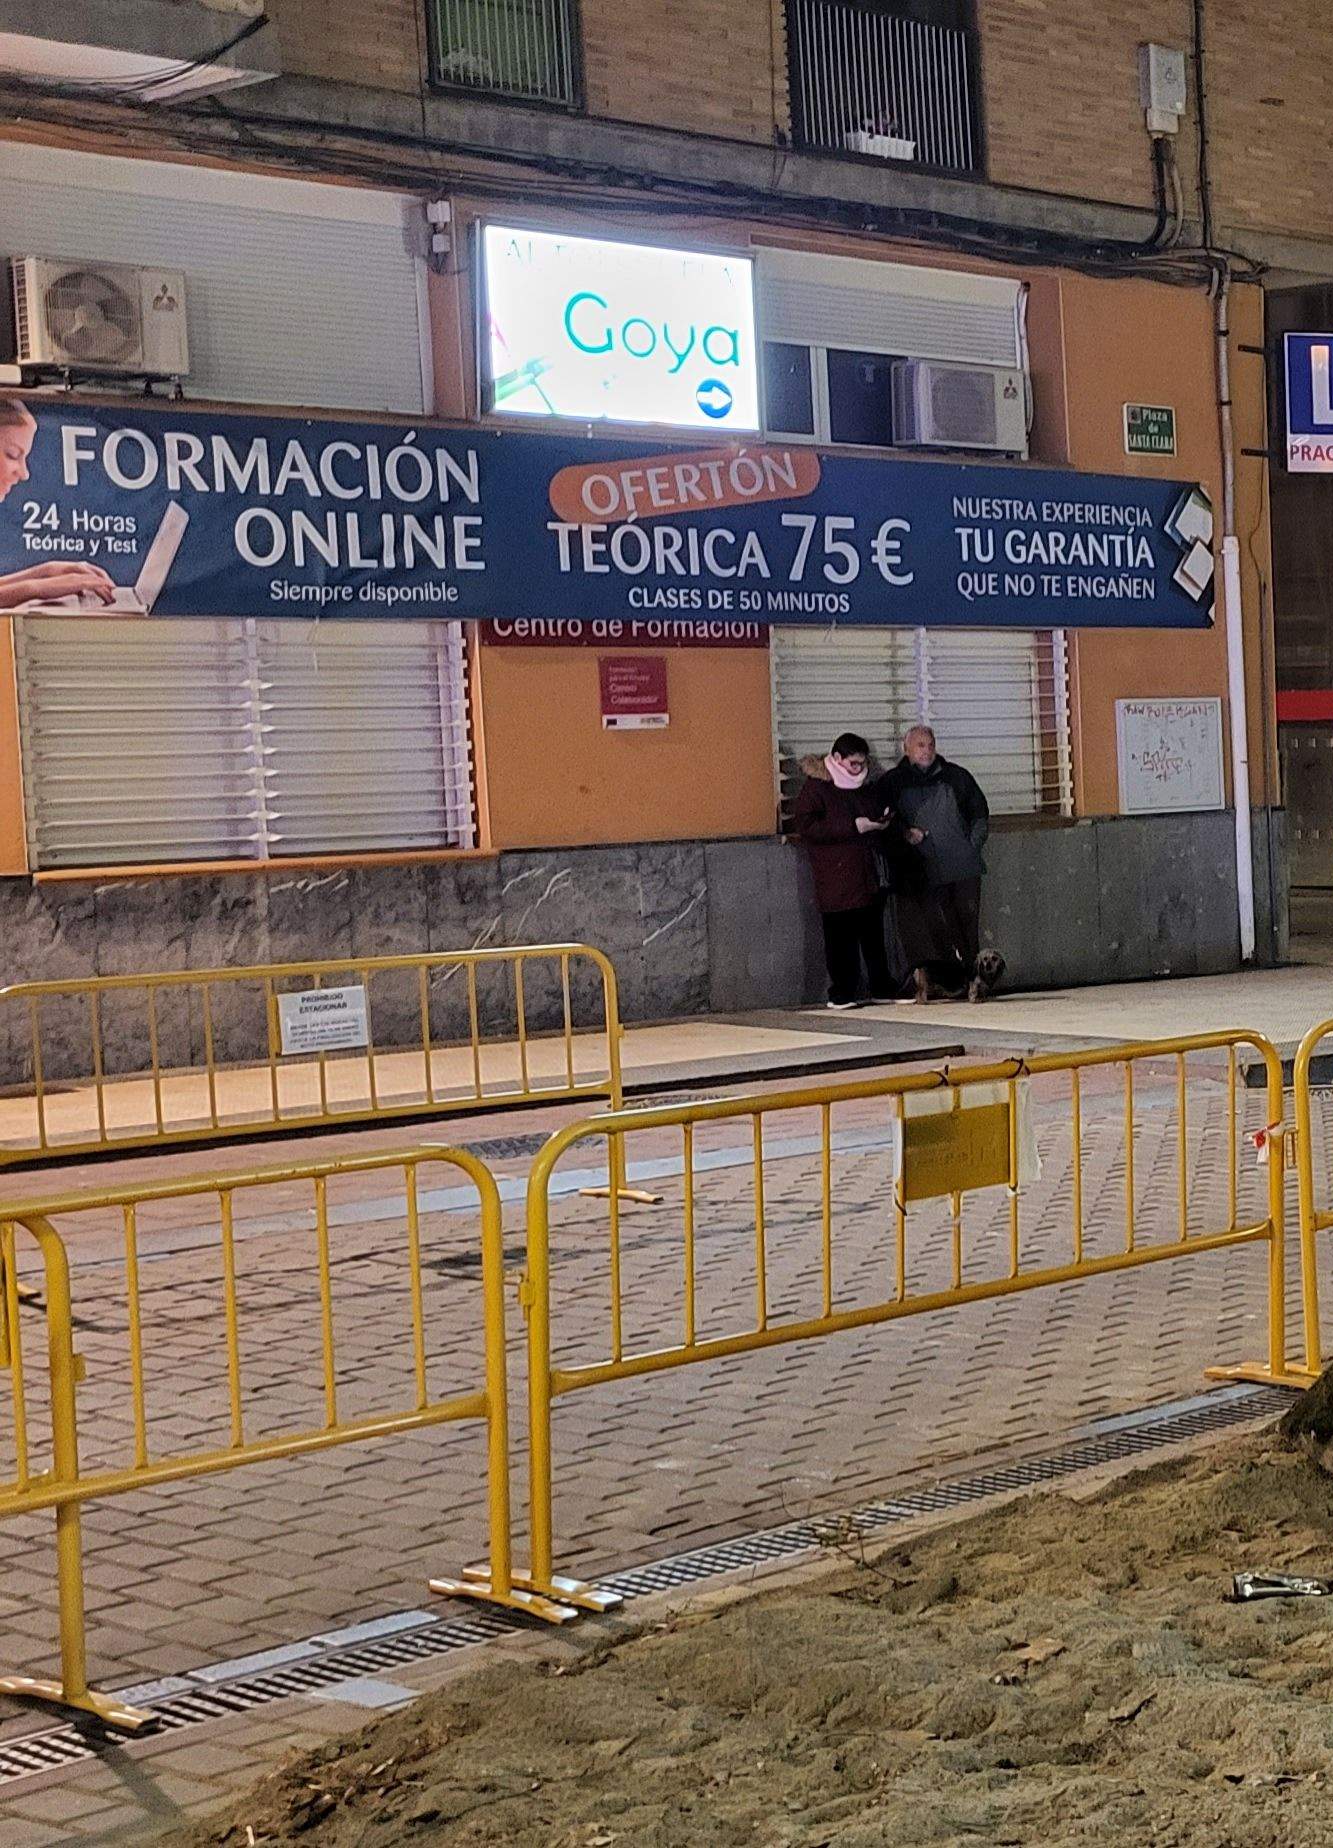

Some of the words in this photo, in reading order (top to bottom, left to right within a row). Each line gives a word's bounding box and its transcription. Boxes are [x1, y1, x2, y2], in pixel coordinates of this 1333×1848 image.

[565, 292, 739, 373] Goya
[311, 345, 364, 425] L
[1142, 408, 1168, 421] Plaza
[61, 425, 480, 504] FORMACIÓN
[581, 449, 798, 515] OFERTÓN
[22, 501, 60, 531] 24
[73, 509, 137, 533] Horas
[953, 496, 1038, 521] NUESTRA
[1042, 502, 1152, 527] EXPERIENCIA
[22, 533, 85, 552] Teórica
[89, 539, 100, 556] y
[105, 536, 138, 553] Test
[234, 507, 486, 570] ONLINE
[547, 512, 771, 579] TEÓRICA
[781, 513, 861, 585] 75
[870, 518, 914, 586] €
[955, 528, 994, 564] TU
[1004, 527, 1155, 568] GARANTÍA
[270, 580, 354, 603] Siempre
[358, 581, 459, 604] disponible
[628, 587, 701, 609] CLASES
[707, 589, 734, 610] DE
[739, 590, 762, 611] 50
[767, 592, 850, 614] MINUTOS
[957, 572, 999, 600] QUE
[1004, 574, 1035, 597] NO
[1040, 575, 1062, 597] TE
[1067, 573, 1155, 600] ENGAÑEN
[493, 618, 582, 638] Centro
